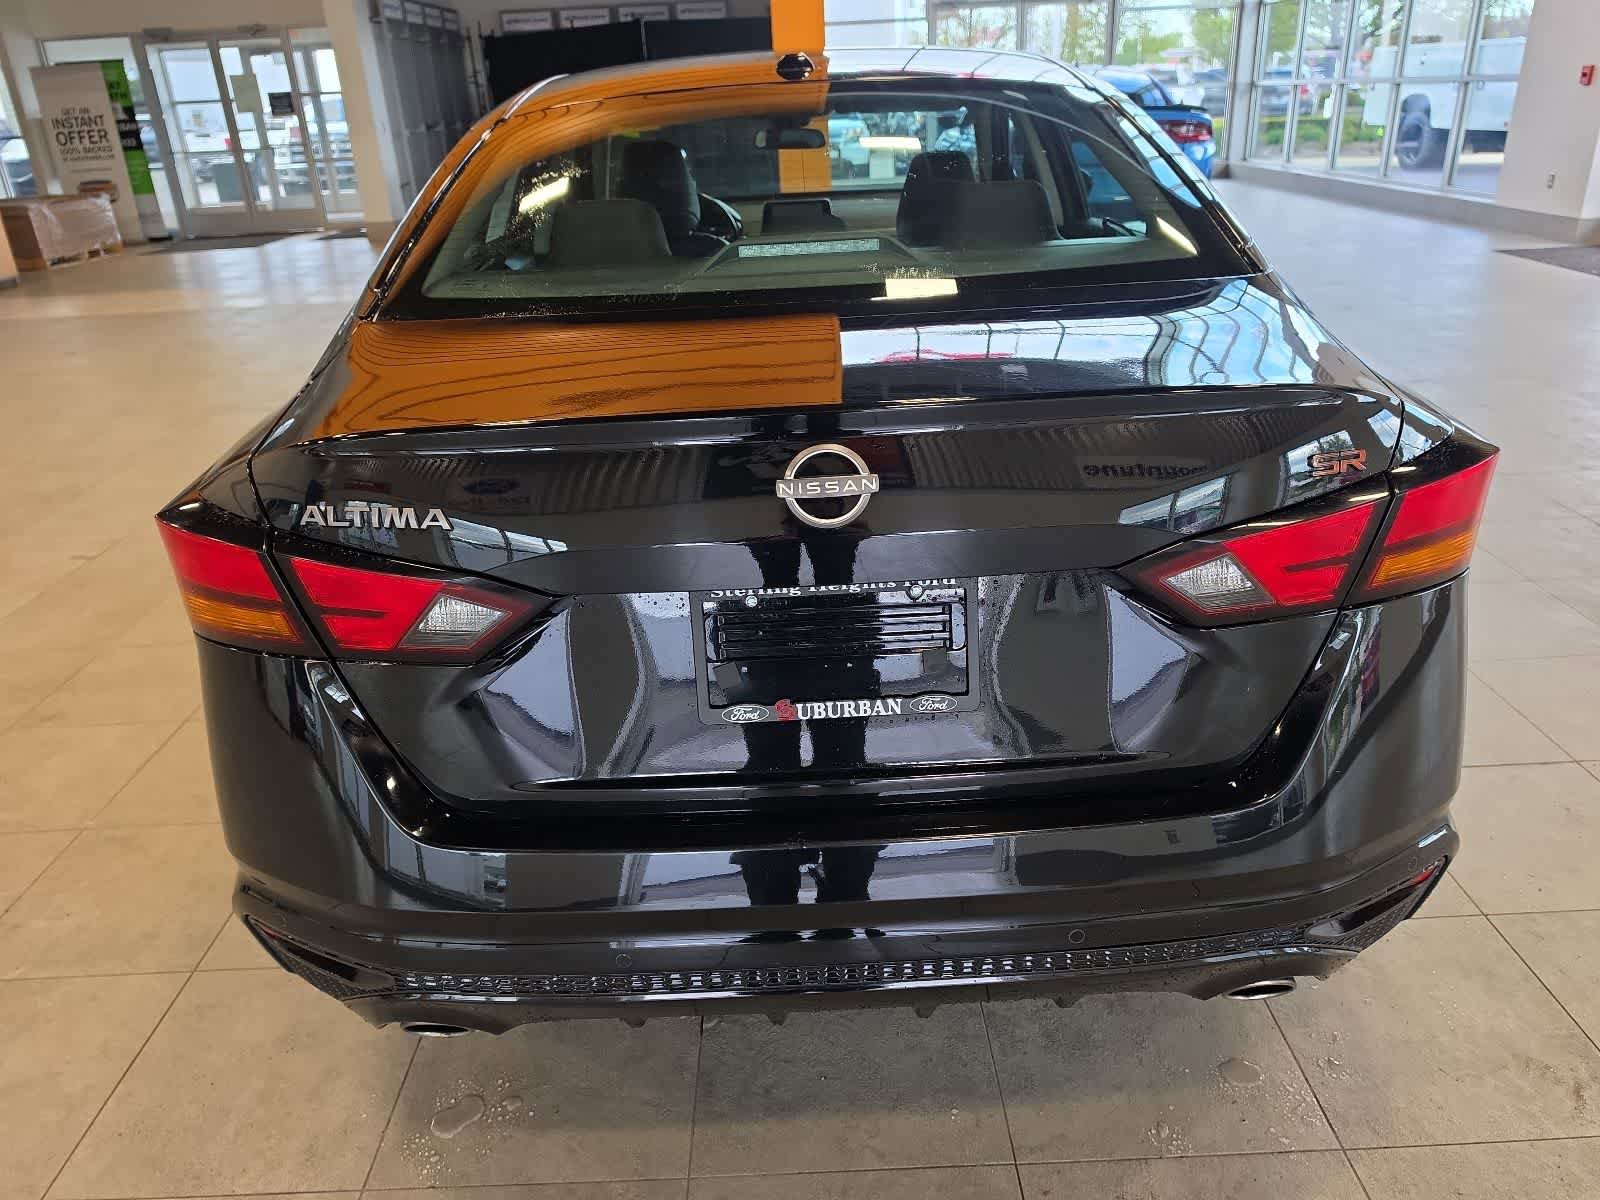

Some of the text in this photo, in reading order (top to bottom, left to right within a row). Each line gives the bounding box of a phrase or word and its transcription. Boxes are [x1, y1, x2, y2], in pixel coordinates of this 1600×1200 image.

[51, 114, 105, 130] INSTANT
[55, 129, 110, 146] OFFER
[1308, 447, 1367, 477] SR
[778, 477, 877, 496] NISSAN
[300, 504, 453, 532] ALTIMA
[775, 698, 902, 722] SUBURBAN
[916, 696, 949, 711] Ford
[728, 706, 762, 722] Ford
